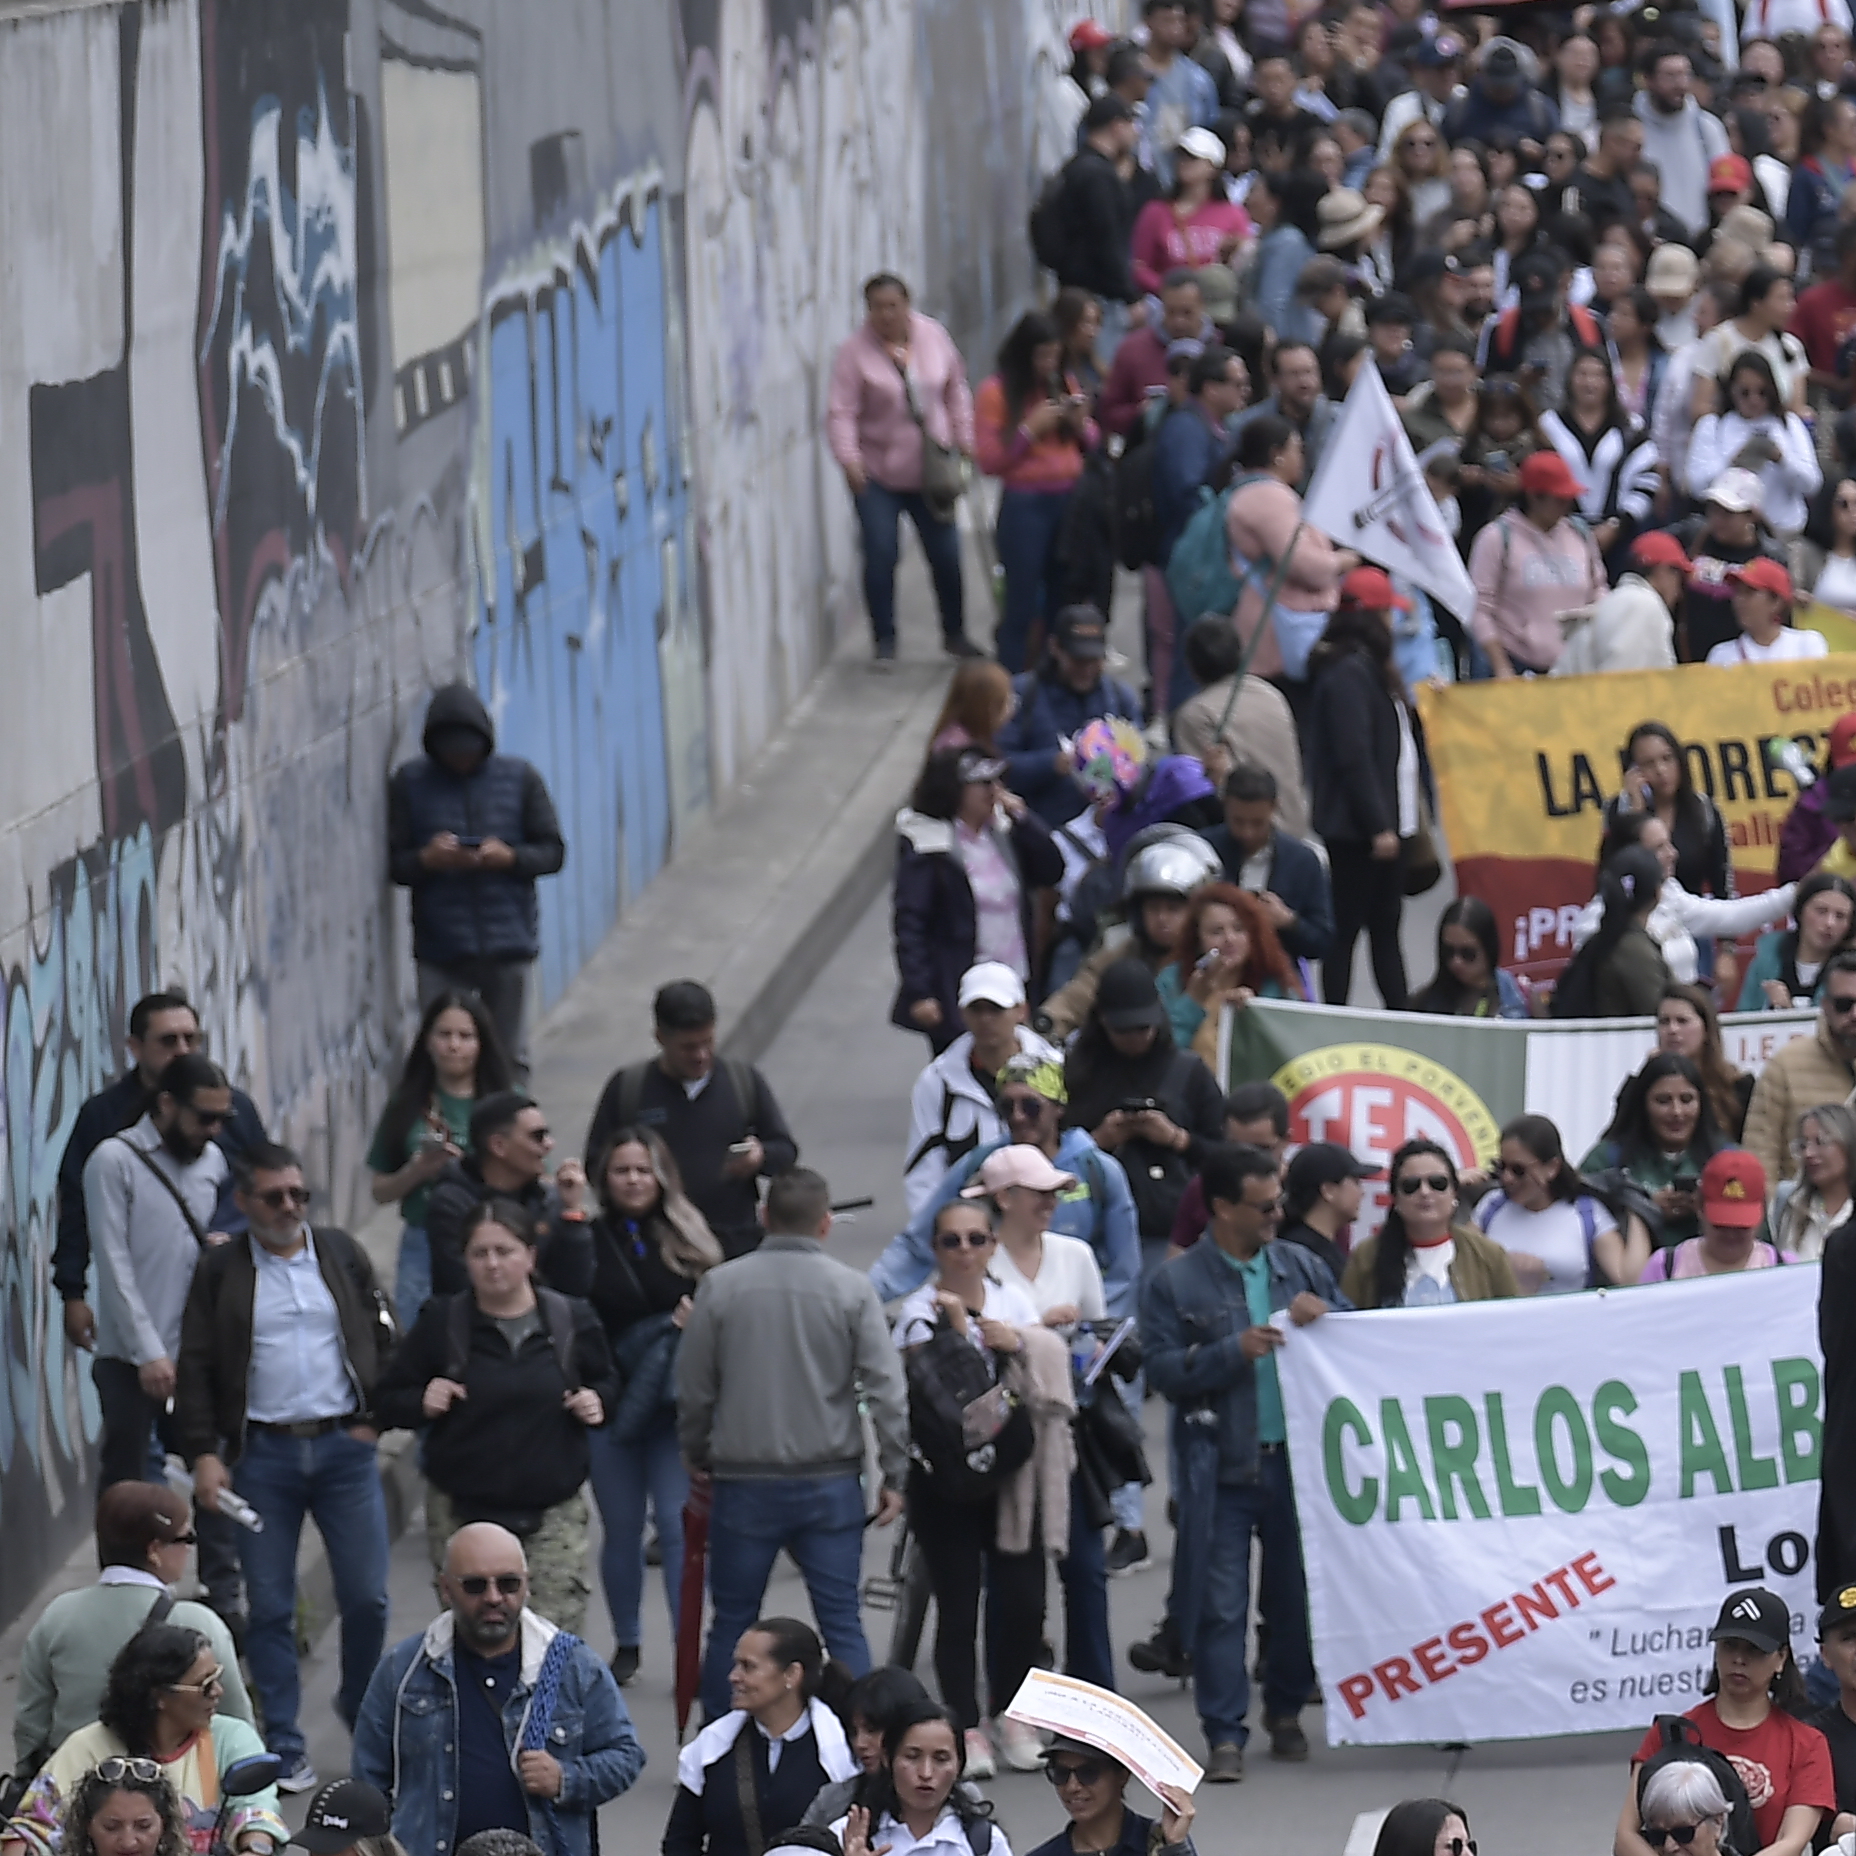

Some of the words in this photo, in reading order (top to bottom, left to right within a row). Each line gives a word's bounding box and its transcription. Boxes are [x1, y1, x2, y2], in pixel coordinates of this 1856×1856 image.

[1536, 752, 1602, 817] LA
[1322, 1378, 1652, 1527] CARLOS
[1335, 1549, 1617, 1721] PRESENTE
[1570, 1676, 1607, 1705] es
